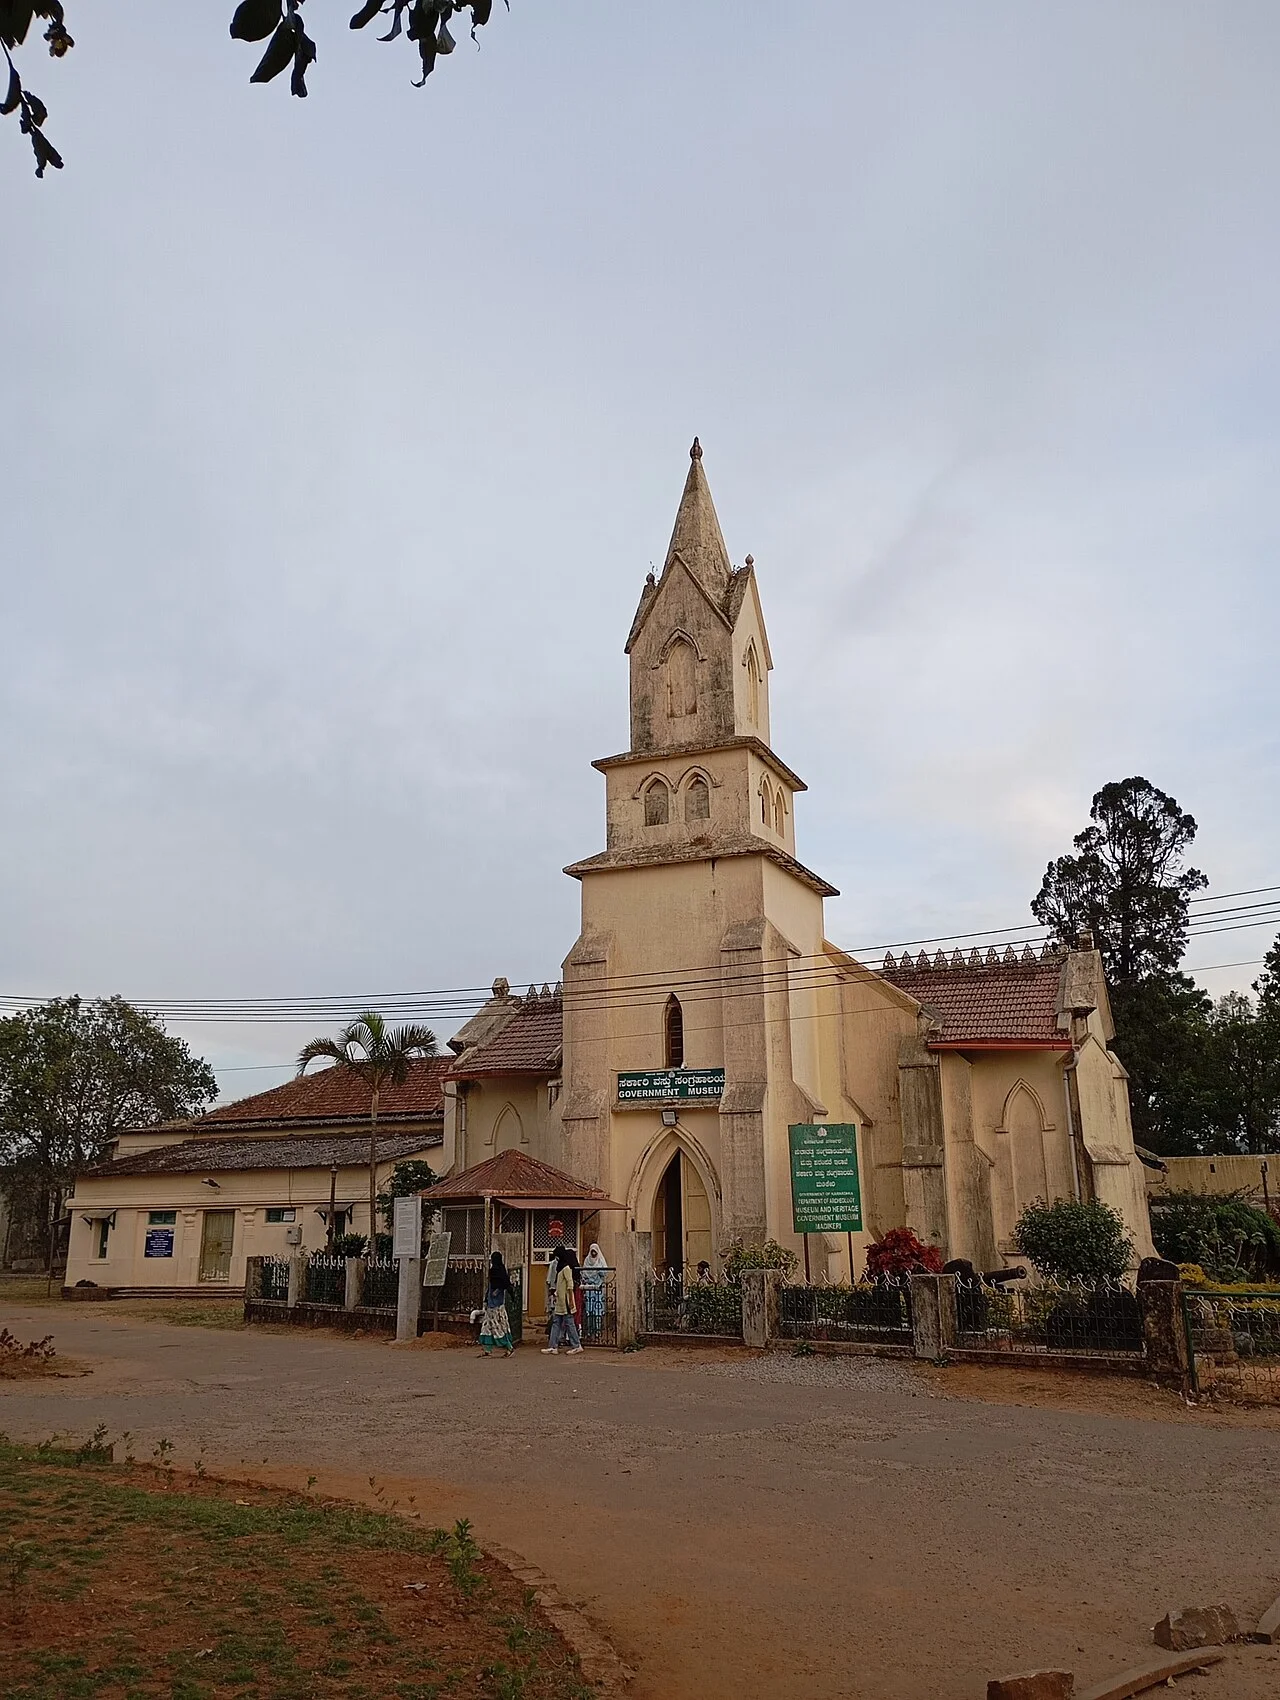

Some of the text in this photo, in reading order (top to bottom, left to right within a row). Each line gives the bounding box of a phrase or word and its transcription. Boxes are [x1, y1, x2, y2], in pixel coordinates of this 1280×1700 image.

[653, 1076, 671, 1088] ವಸ್ತು
[618, 1088, 680, 1098] GOVERNMENT
[795, 1206, 819, 1214] MUSEUM
[832, 1204, 860, 1212] HERITAGE
[796, 1213, 859, 1222] GOVERNMENT MUSEUM
